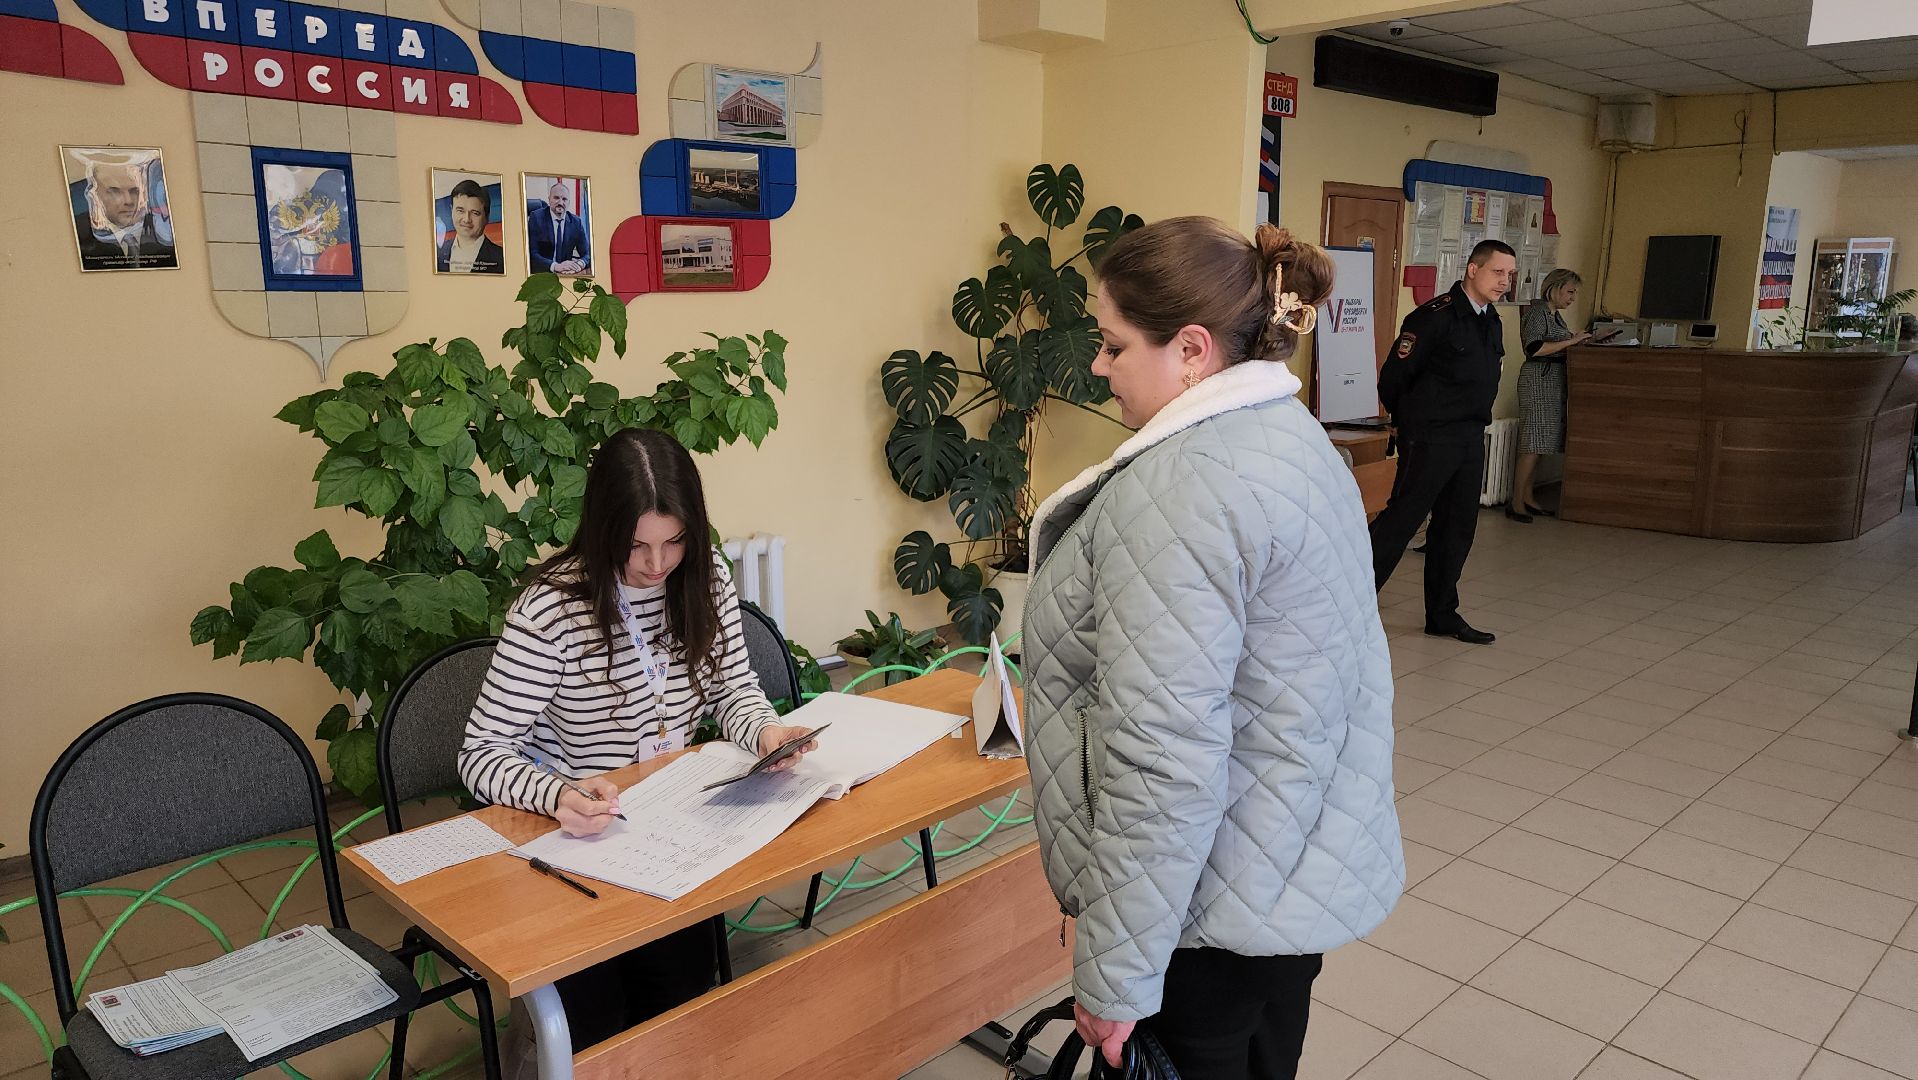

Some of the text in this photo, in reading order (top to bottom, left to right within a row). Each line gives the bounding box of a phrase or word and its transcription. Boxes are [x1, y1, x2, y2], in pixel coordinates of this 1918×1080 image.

[143, 0, 426, 59] ВПЕРЕД
[202, 51, 471, 109] РОССИЯ
[1266, 78, 1294, 97] СТЕНД
[1271, 96, 1291, 113] 808
